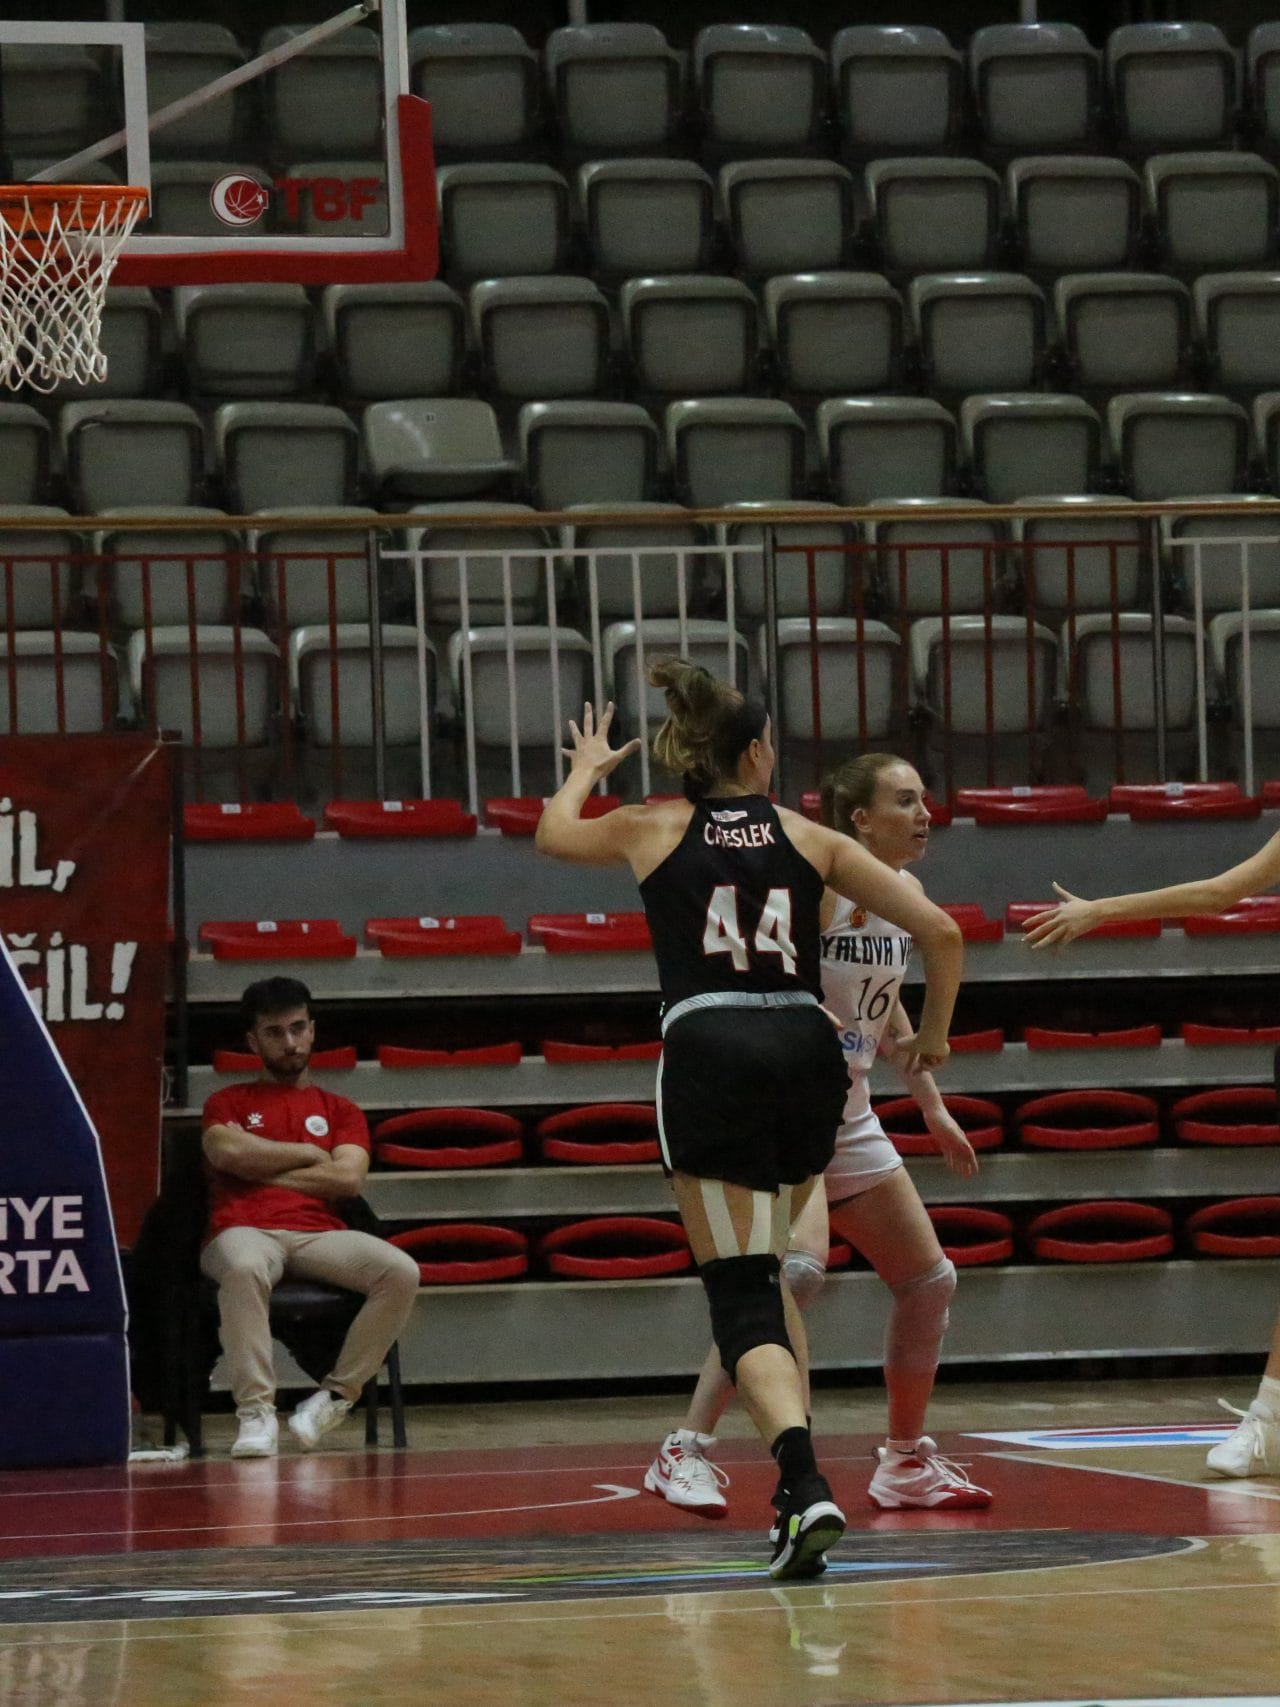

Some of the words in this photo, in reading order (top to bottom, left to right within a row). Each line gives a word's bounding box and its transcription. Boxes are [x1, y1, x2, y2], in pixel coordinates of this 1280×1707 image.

[274, 176, 380, 221] TBF
[702, 885, 798, 976] 44
[854, 977, 896, 1021] 16
